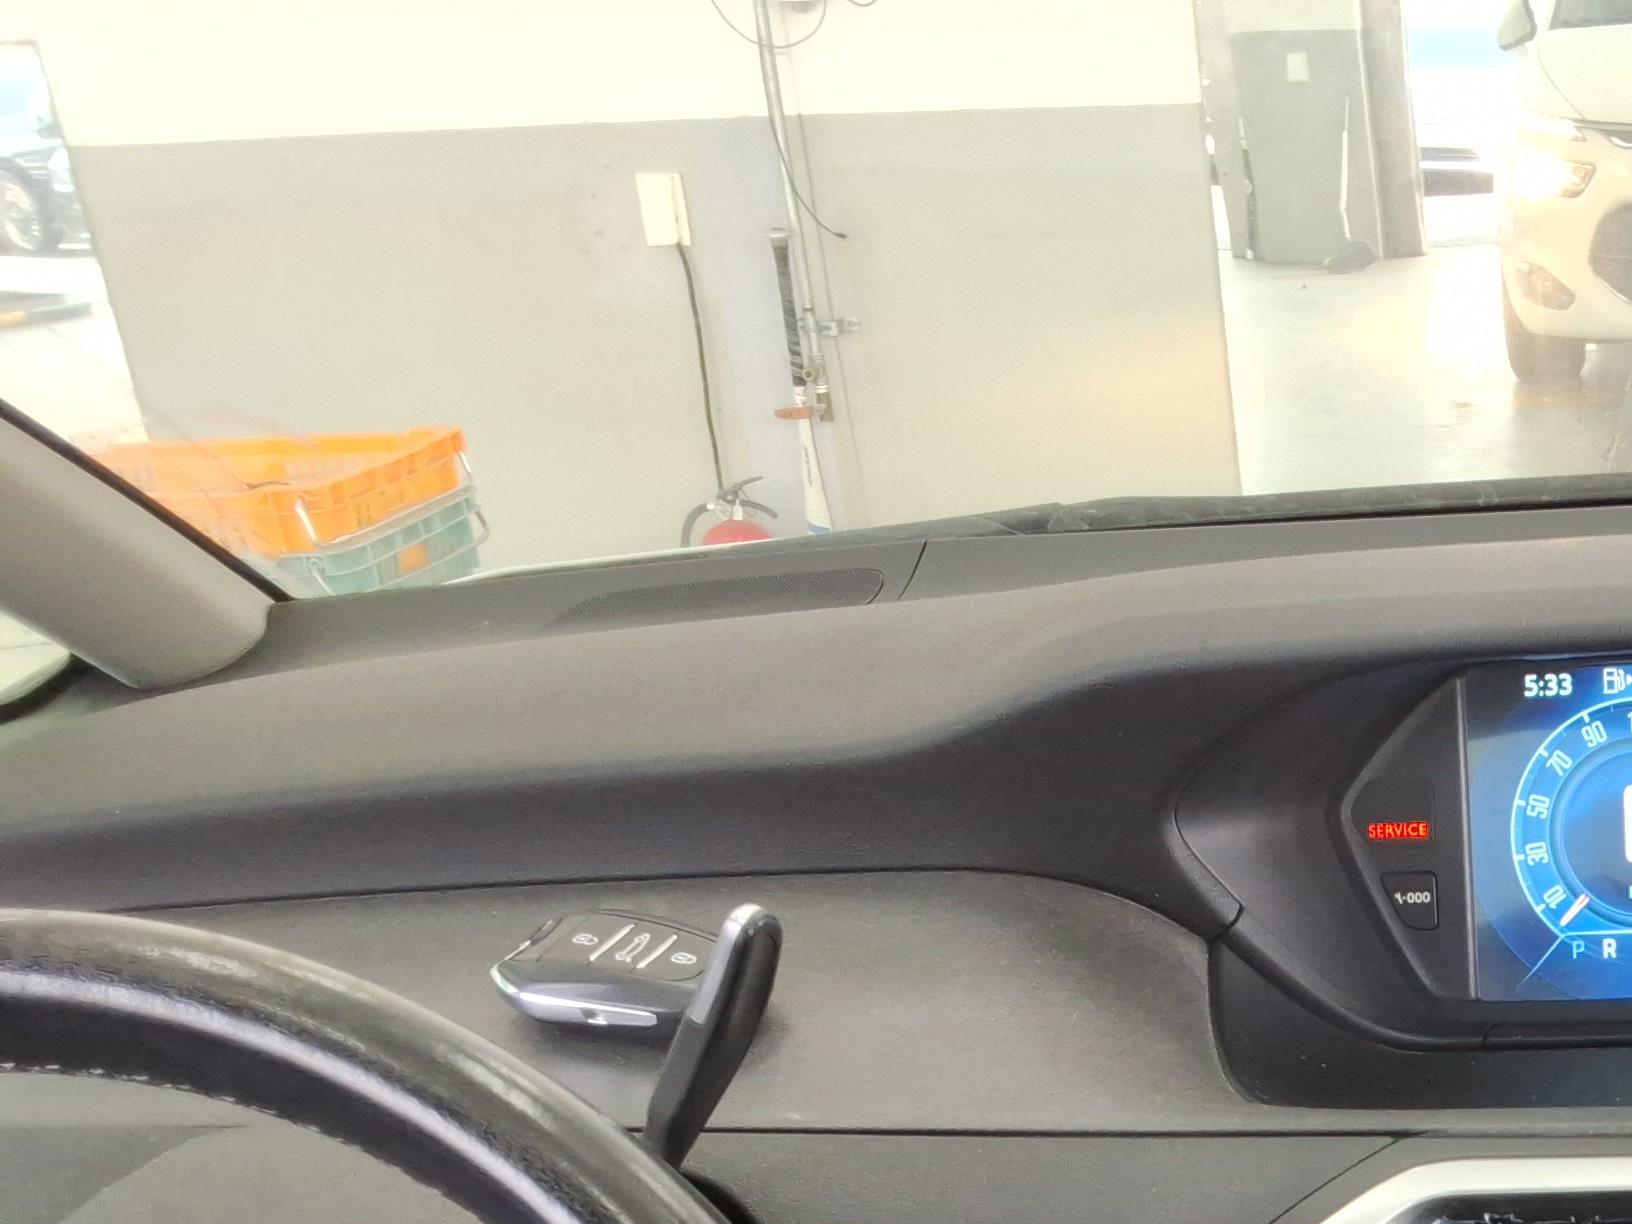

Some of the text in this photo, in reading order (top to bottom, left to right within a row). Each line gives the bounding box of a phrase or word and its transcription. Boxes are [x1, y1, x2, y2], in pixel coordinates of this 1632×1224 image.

[1524, 673, 1573, 697] 5:33
[1581, 720, 1608, 748] 90
[1547, 748, 1573, 776] 70
[1526, 794, 1551, 819] 50
[1368, 822, 1428, 839] SERVICE
[1525, 841, 1549, 865] 30
[1543, 884, 1567, 909] 10
[1602, 940, 1616, 958] R
